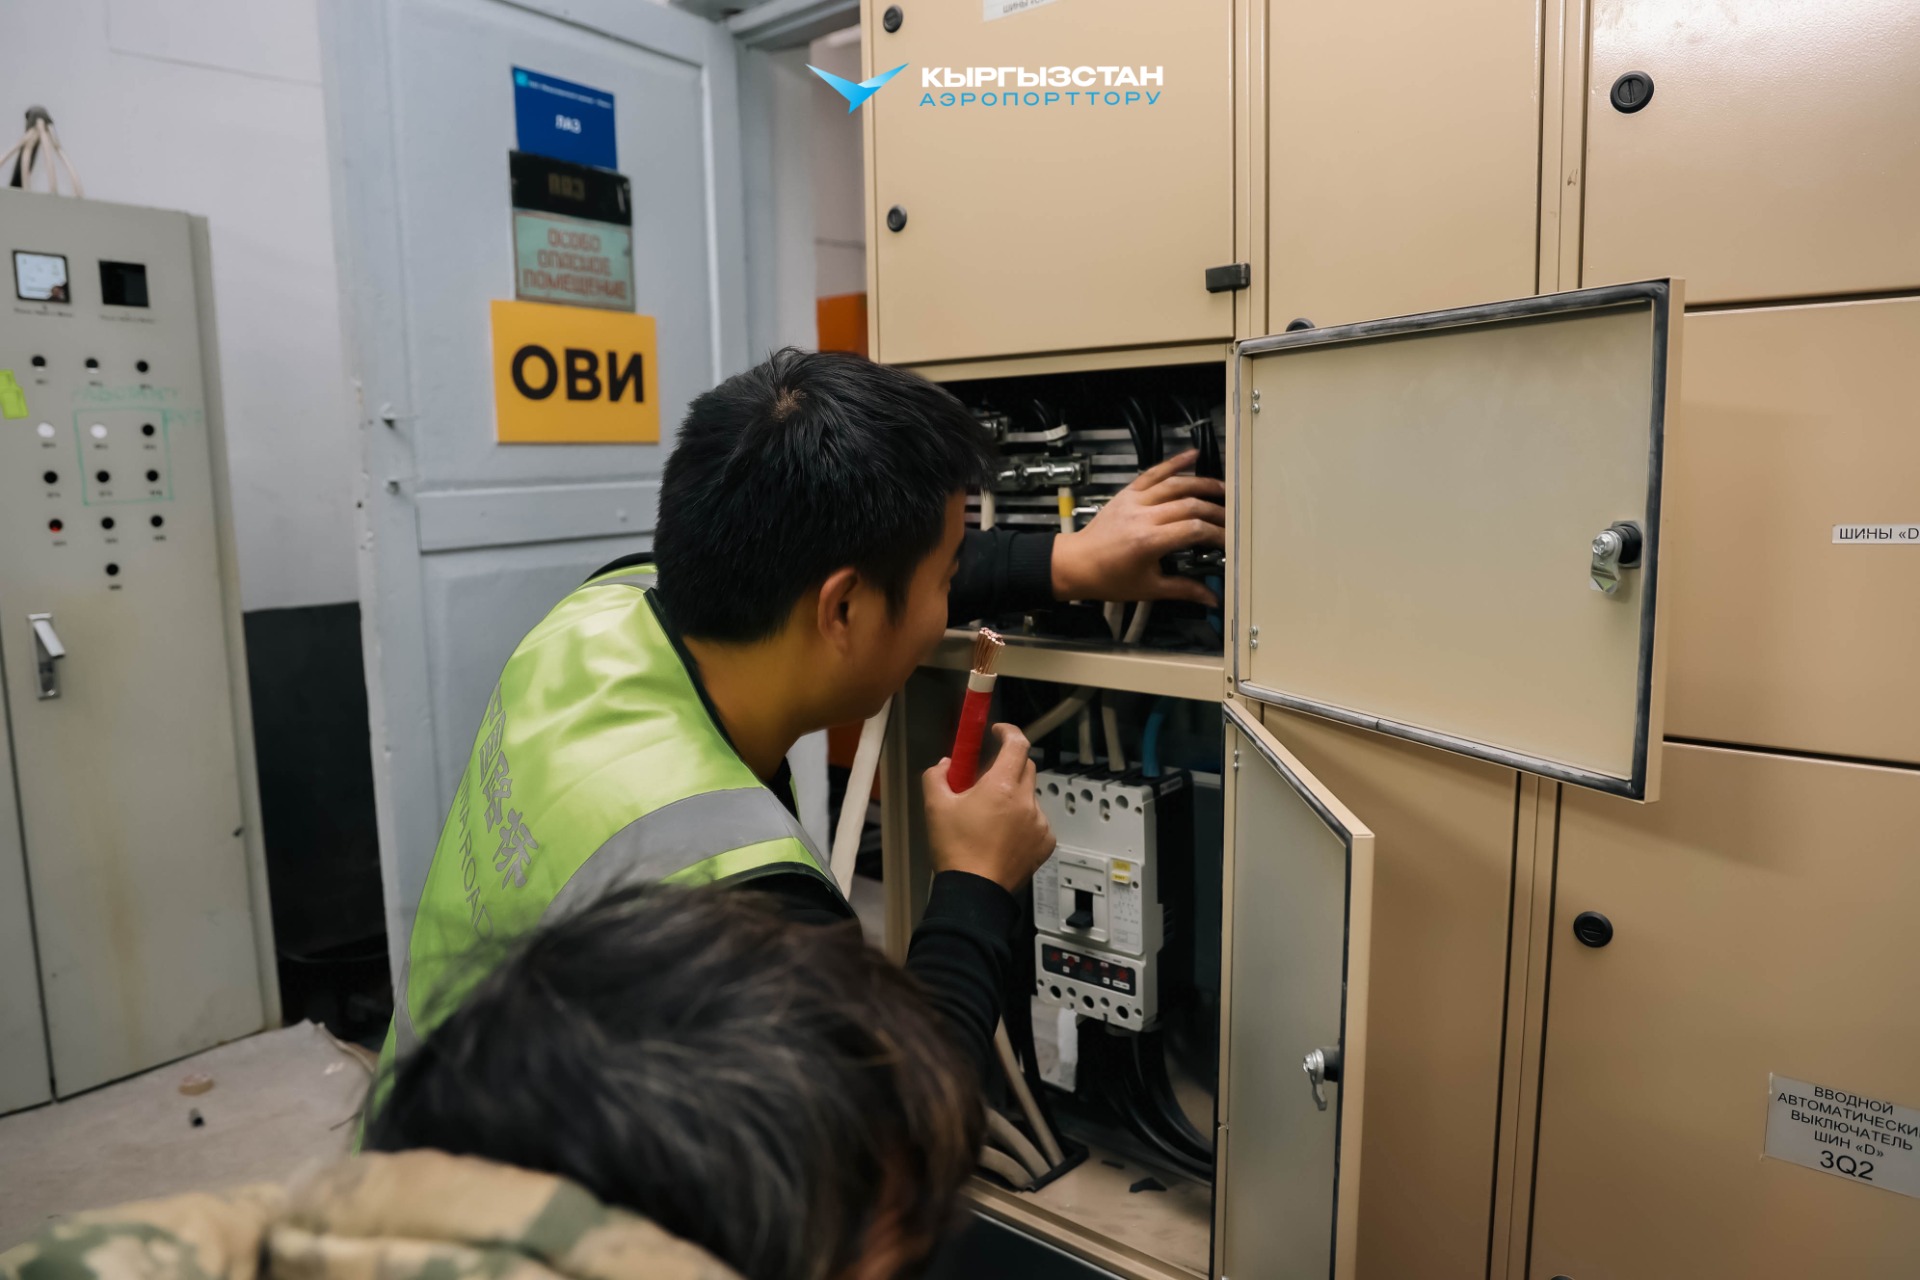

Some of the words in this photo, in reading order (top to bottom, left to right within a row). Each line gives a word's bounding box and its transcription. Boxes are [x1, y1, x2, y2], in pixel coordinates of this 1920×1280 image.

[547, 228, 602, 253] ОСОБО
[537, 248, 612, 276] ОПАСНОЕ
[522, 267, 627, 300] ПОМЕЩЕНИЕ
[511, 344, 645, 404] ОВИ
[1839, 527, 1893, 540] ШИНЫ
[1777, 1092, 1920, 1139] АВТОМАТИЧЕСКИ
[1813, 1085, 1894, 1116] ВВОДНОЙ
[1790, 1109, 1913, 1151] ВЫКЛЮЧАТЕЛЬ
[1814, 1130, 1851, 1149] ШИН
[1855, 1143, 1884, 1158] «D»
[1819, 1150, 1875, 1181] 3Q2
